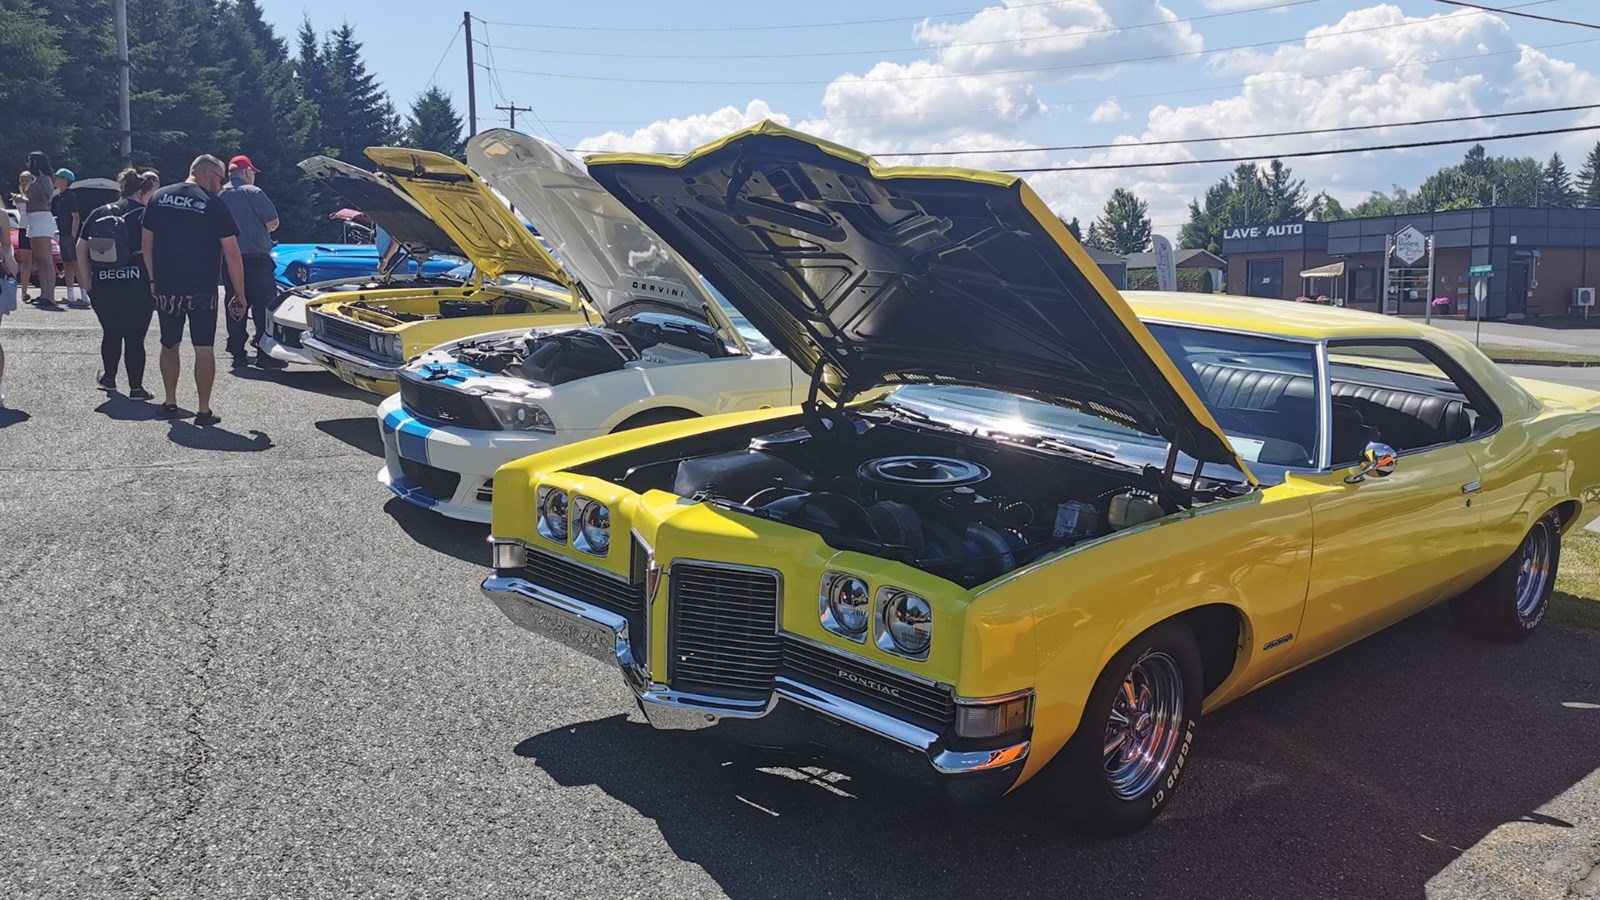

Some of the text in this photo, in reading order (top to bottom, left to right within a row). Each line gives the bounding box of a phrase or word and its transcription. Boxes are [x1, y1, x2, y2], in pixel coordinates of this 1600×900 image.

[158, 193, 194, 208] JACK
[1266, 223, 1303, 237] AUTO
[99, 269, 140, 280] BEGIN
[632, 281, 684, 297] CERVINI
[838, 670, 900, 697] PONTIAC
[1151, 719, 1196, 809] LEGEND GT
